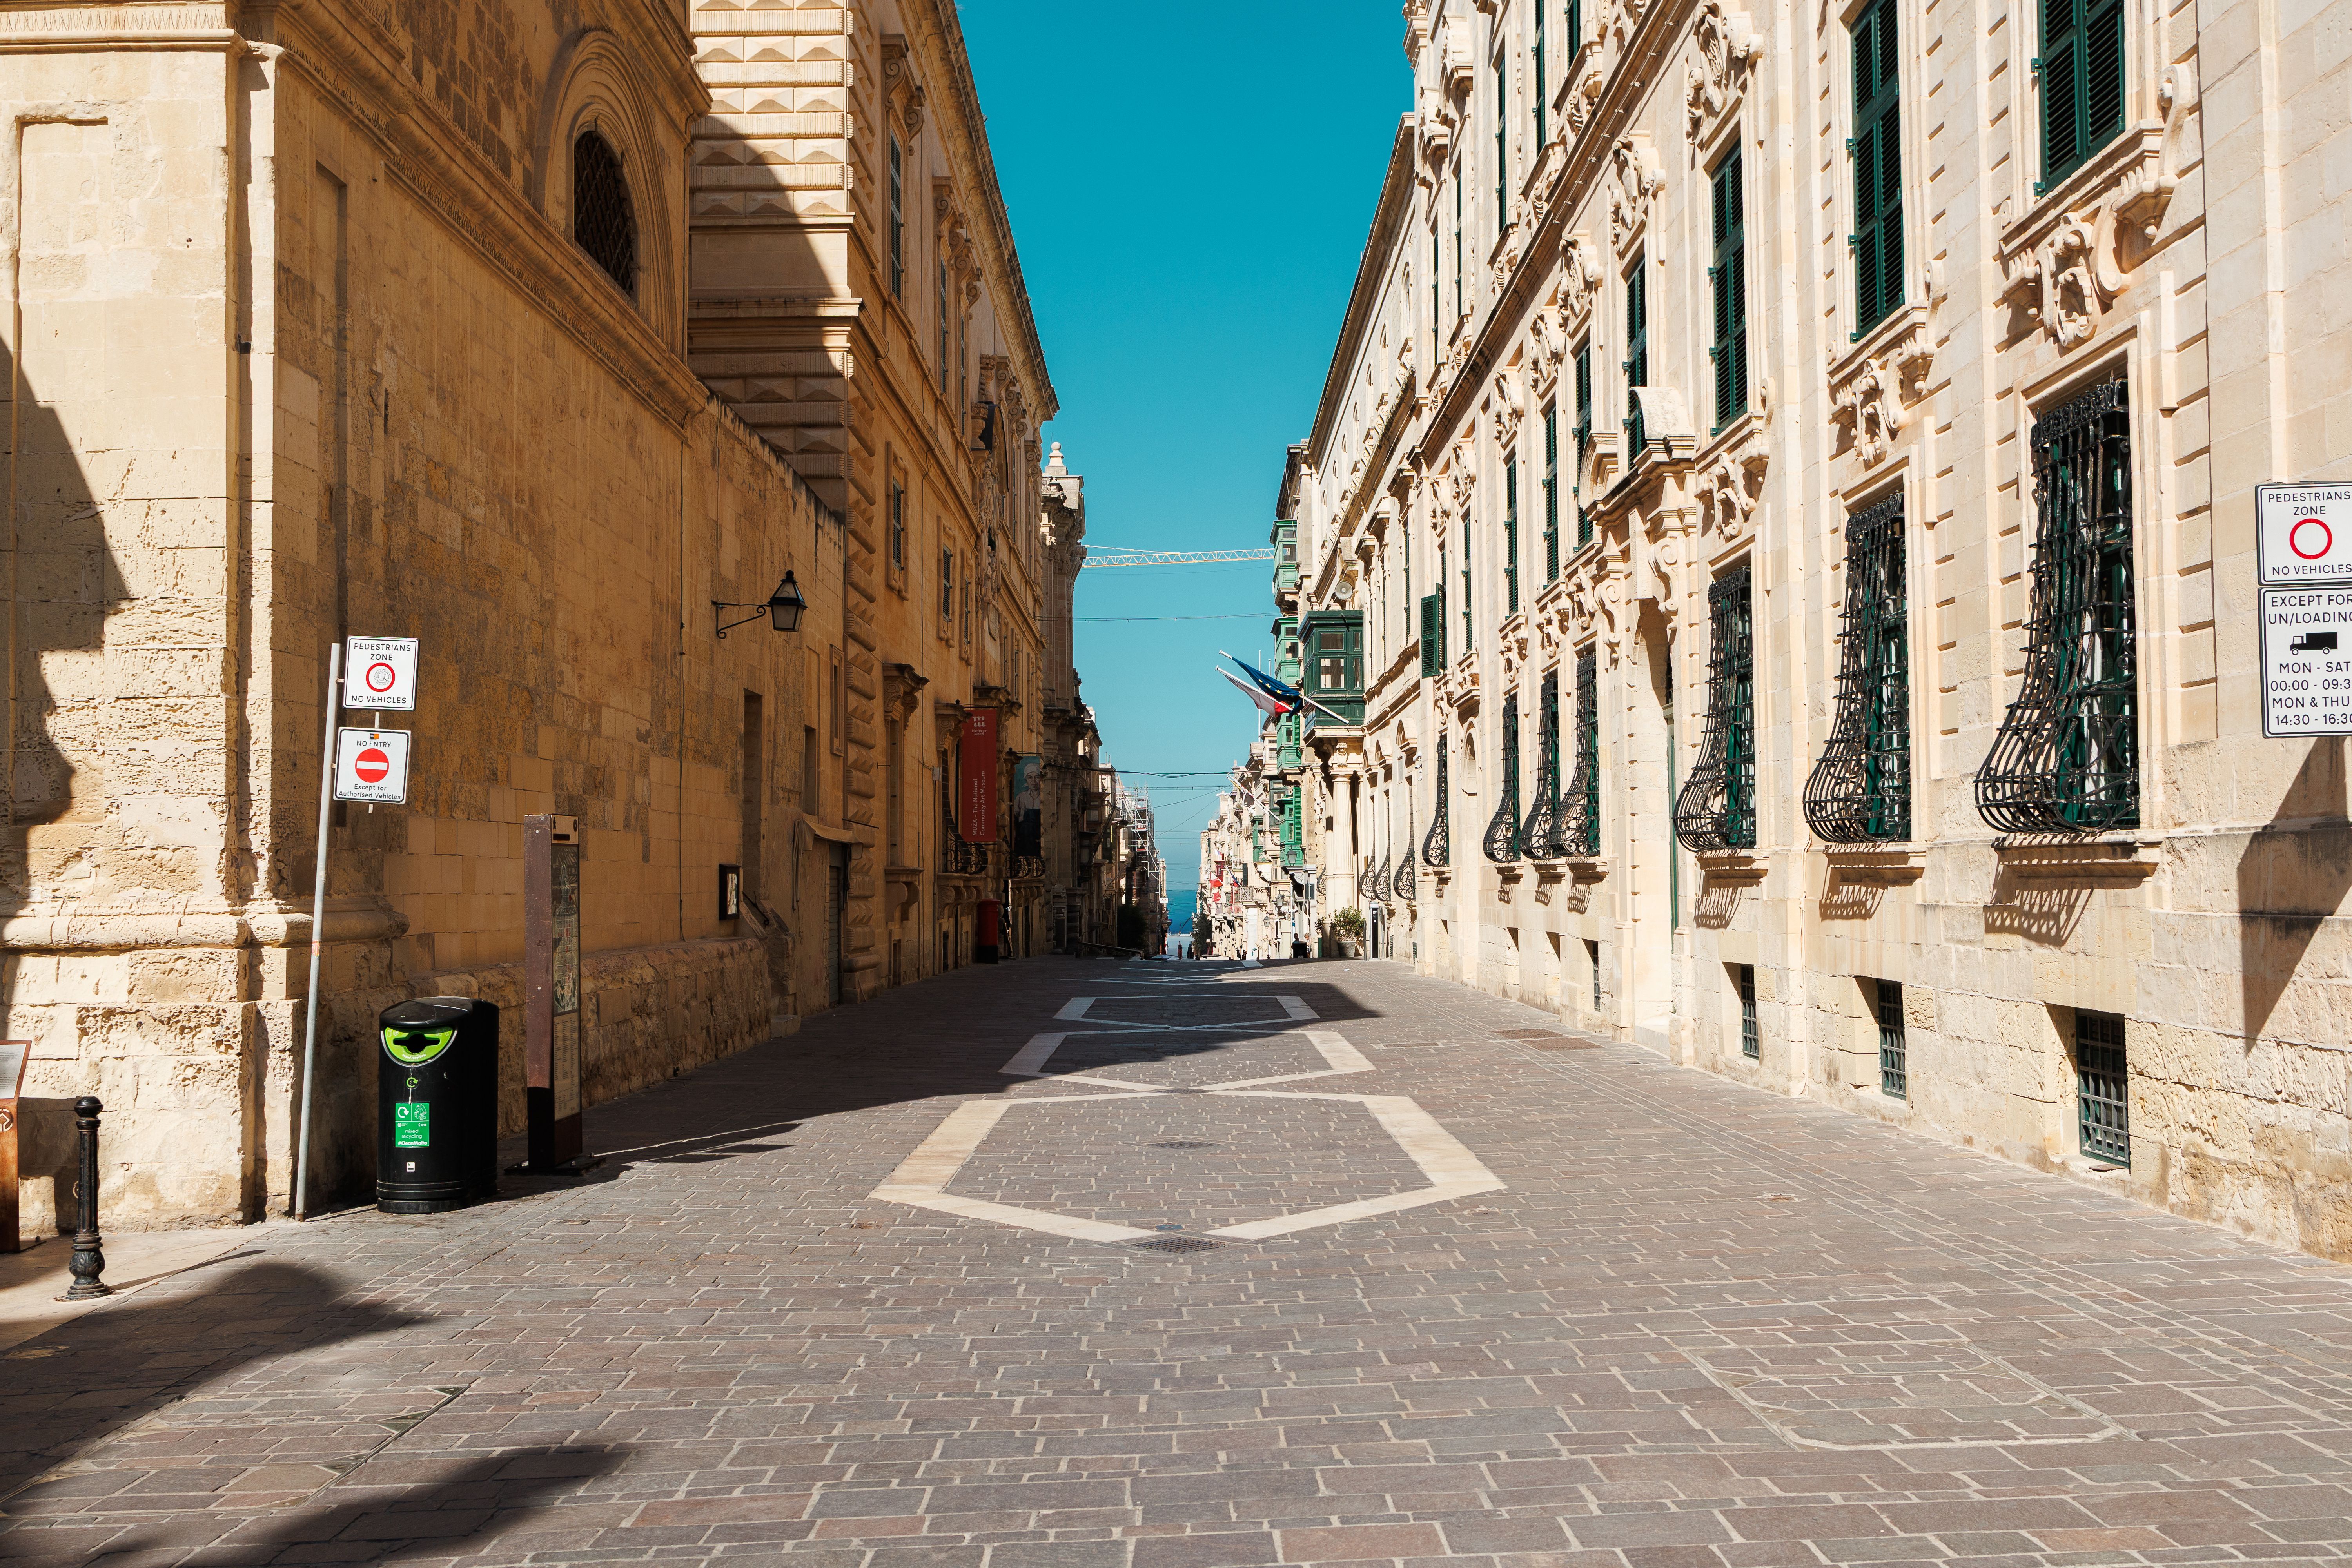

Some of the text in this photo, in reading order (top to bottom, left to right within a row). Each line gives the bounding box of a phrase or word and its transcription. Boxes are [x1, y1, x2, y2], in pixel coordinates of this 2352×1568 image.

[2269, 491, 2350, 503] PEDESTRIANS
[2294, 506, 2326, 515] ZONE
[2272, 564, 2352, 575] NO VEHICLES
[2272, 594, 2352, 607] EXCEPT FOR
[354, 643, 411, 652] PEDESTRIANS
[2279, 662, 2311, 673] MON
[2326, 661, 2351, 672] SAT
[2270, 680, 2309, 691] 00:00
[2323, 679, 2350, 690] 09:3
[2273, 696, 2350, 708] MON & THU
[2275, 714, 2310, 726] 14:30
